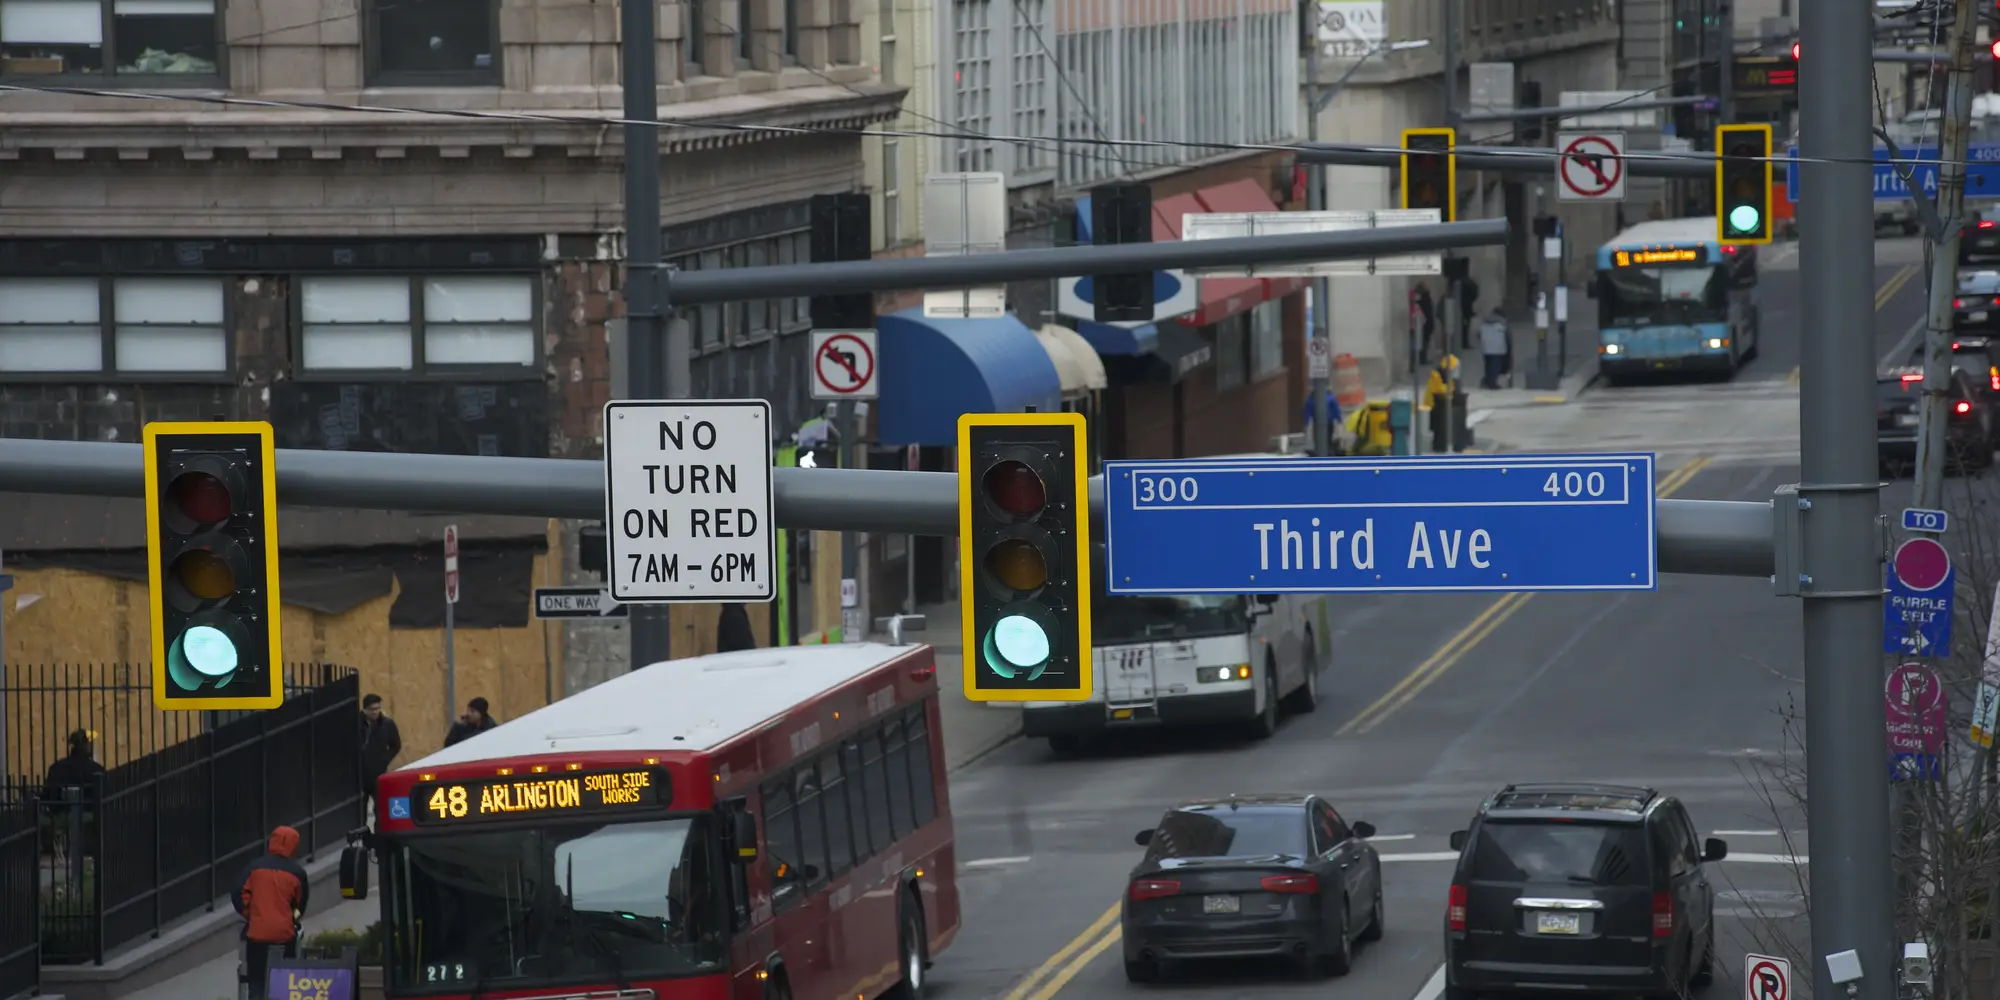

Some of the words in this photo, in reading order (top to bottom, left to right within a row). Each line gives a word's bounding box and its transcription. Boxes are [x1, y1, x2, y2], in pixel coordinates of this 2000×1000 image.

[659, 420, 717, 450] NO
[642, 464, 737, 494] TURN
[1140, 477, 1198, 502] 300
[1543, 471, 1605, 497] 400
[623, 508, 668, 539] ON
[690, 508, 758, 538] RED
[1913, 513, 1937, 528] TO
[1253, 517, 1375, 570] Third
[1407, 521, 1492, 569] Ave
[545, 596, 571, 610] ONE
[575, 596, 600, 609] WAY
[429, 785, 468, 818] 48
[480, 779, 580, 814] ARLINGTON
[585, 772, 620, 792] SOUTH
[623, 771, 650, 788] SIDE
[602, 787, 640, 805] WORKS
[289, 973, 333, 991] Low
